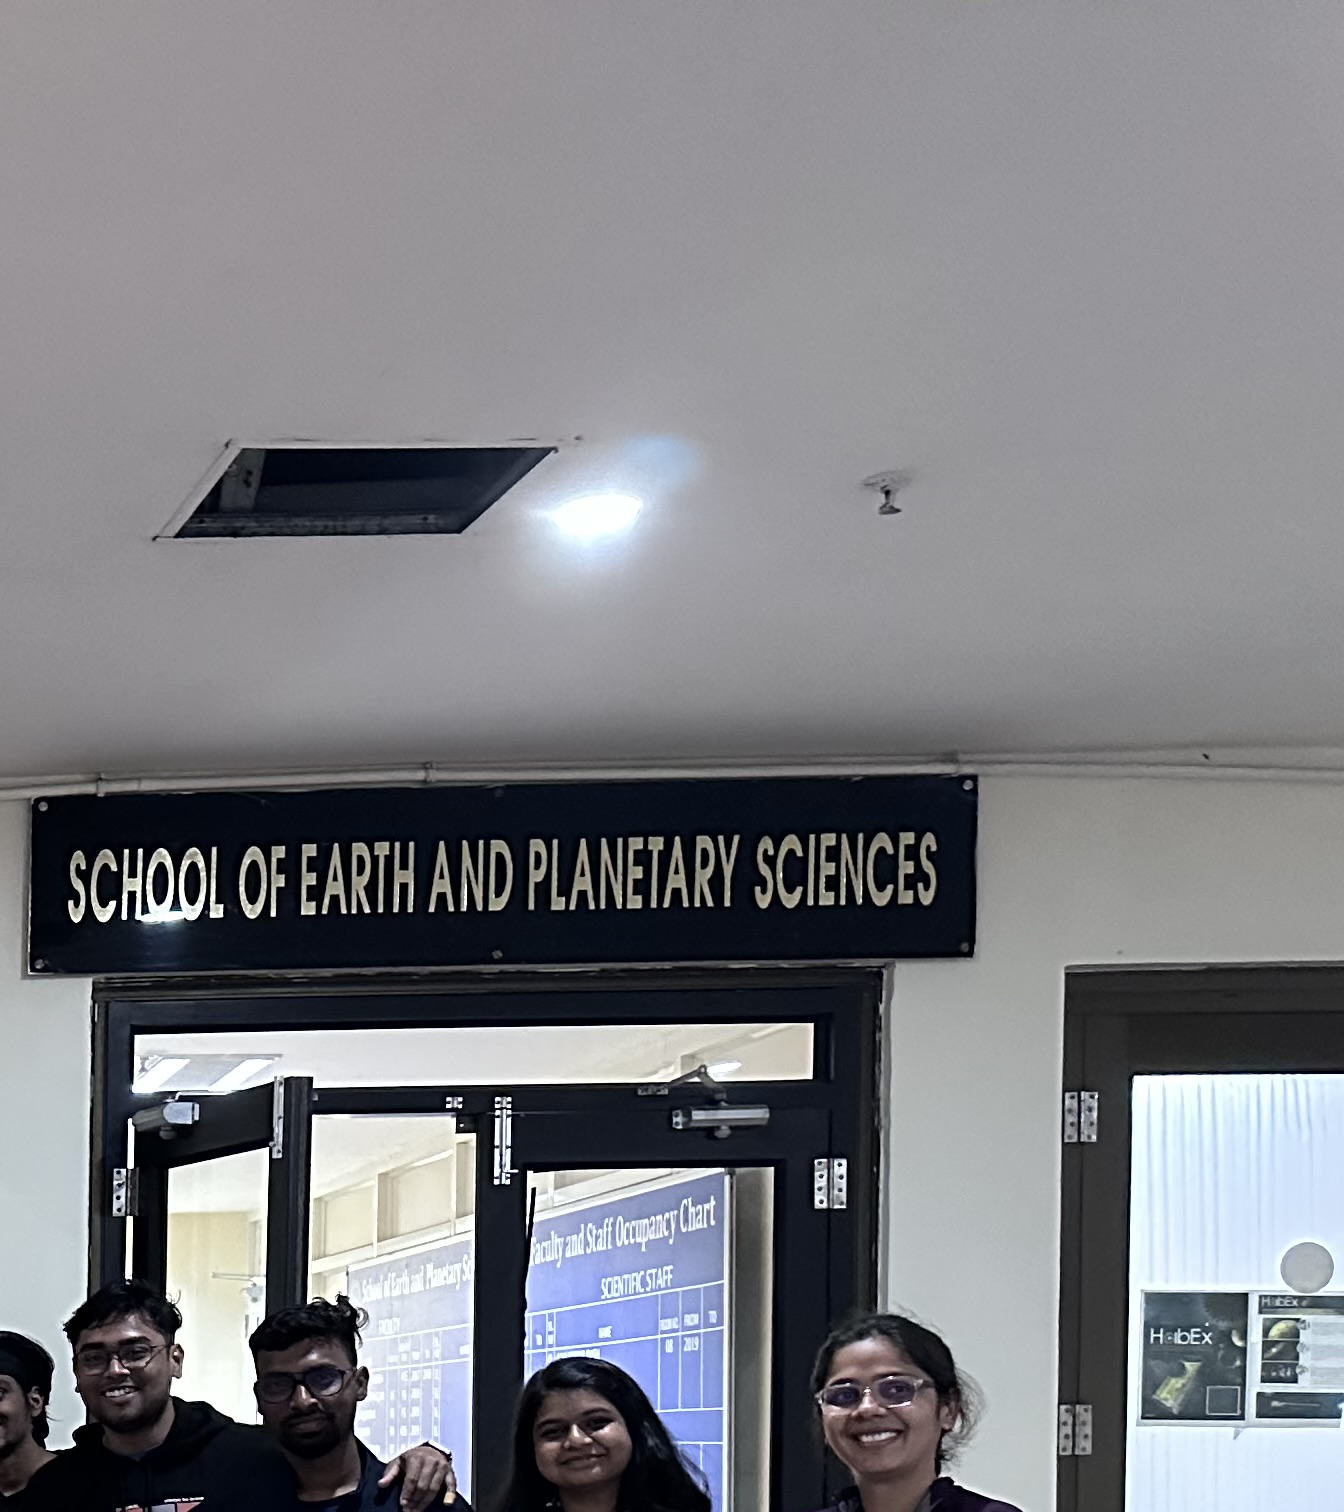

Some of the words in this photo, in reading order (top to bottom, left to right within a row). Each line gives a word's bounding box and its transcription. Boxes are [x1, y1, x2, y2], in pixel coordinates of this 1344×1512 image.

[67, 847, 226, 923] SCHOOL
[237, 844, 287, 920] OF
[300, 840, 415, 917] EARTH
[428, 837, 514, 913] AND
[527, 833, 741, 911] PLANETARY
[753, 830, 939, 908] SCIENCES
[529, 1230, 564, 1268] Faculty
[565, 1224, 585, 1258] and
[586, 1217, 613, 1254] Staff
[615, 1210, 678, 1252] Occupancy
[680, 1196, 716, 1233] Chart
[601, 1268, 644, 1300] SCIENTIFIC
[645, 1264, 674, 1291] STAFF
